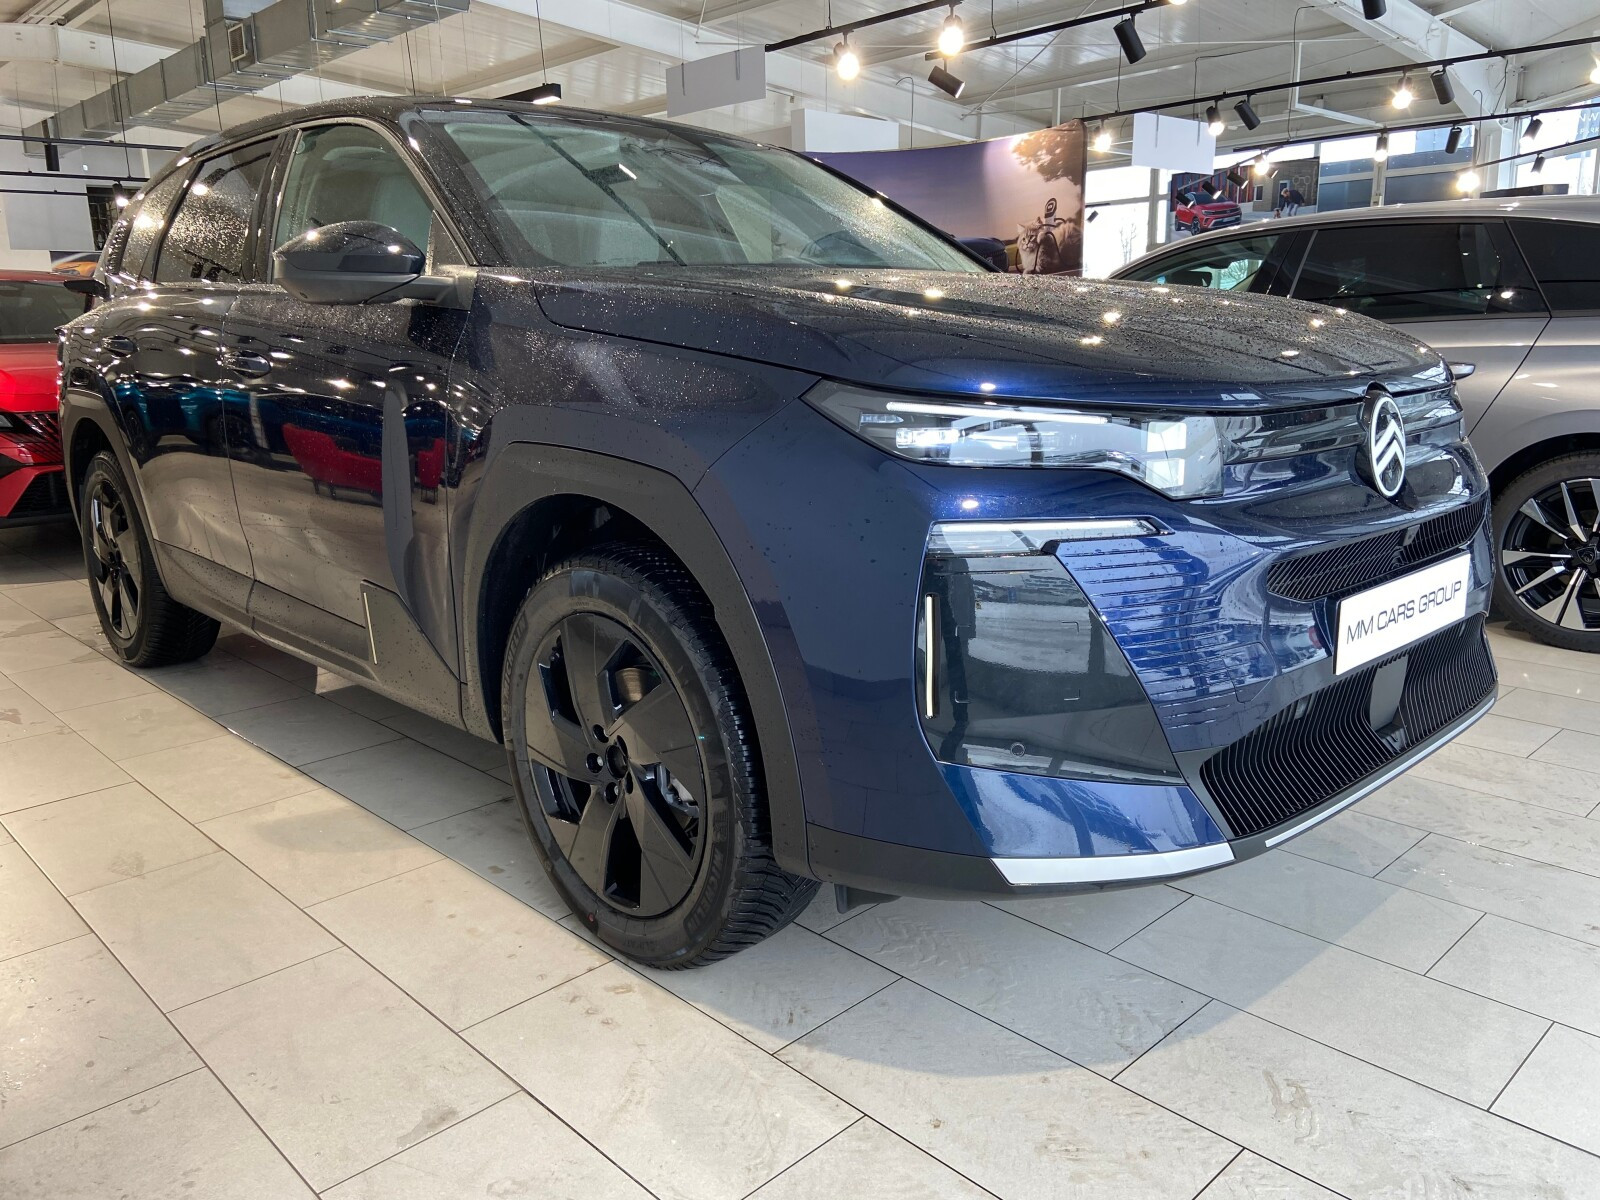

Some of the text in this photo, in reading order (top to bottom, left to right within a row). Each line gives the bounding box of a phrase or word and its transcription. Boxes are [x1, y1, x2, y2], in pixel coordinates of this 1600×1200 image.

[1347, 580, 1462, 644] MM CARS GROUP
[503, 615, 526, 700] MICHELIN
[686, 847, 724, 934] MICHELIN
